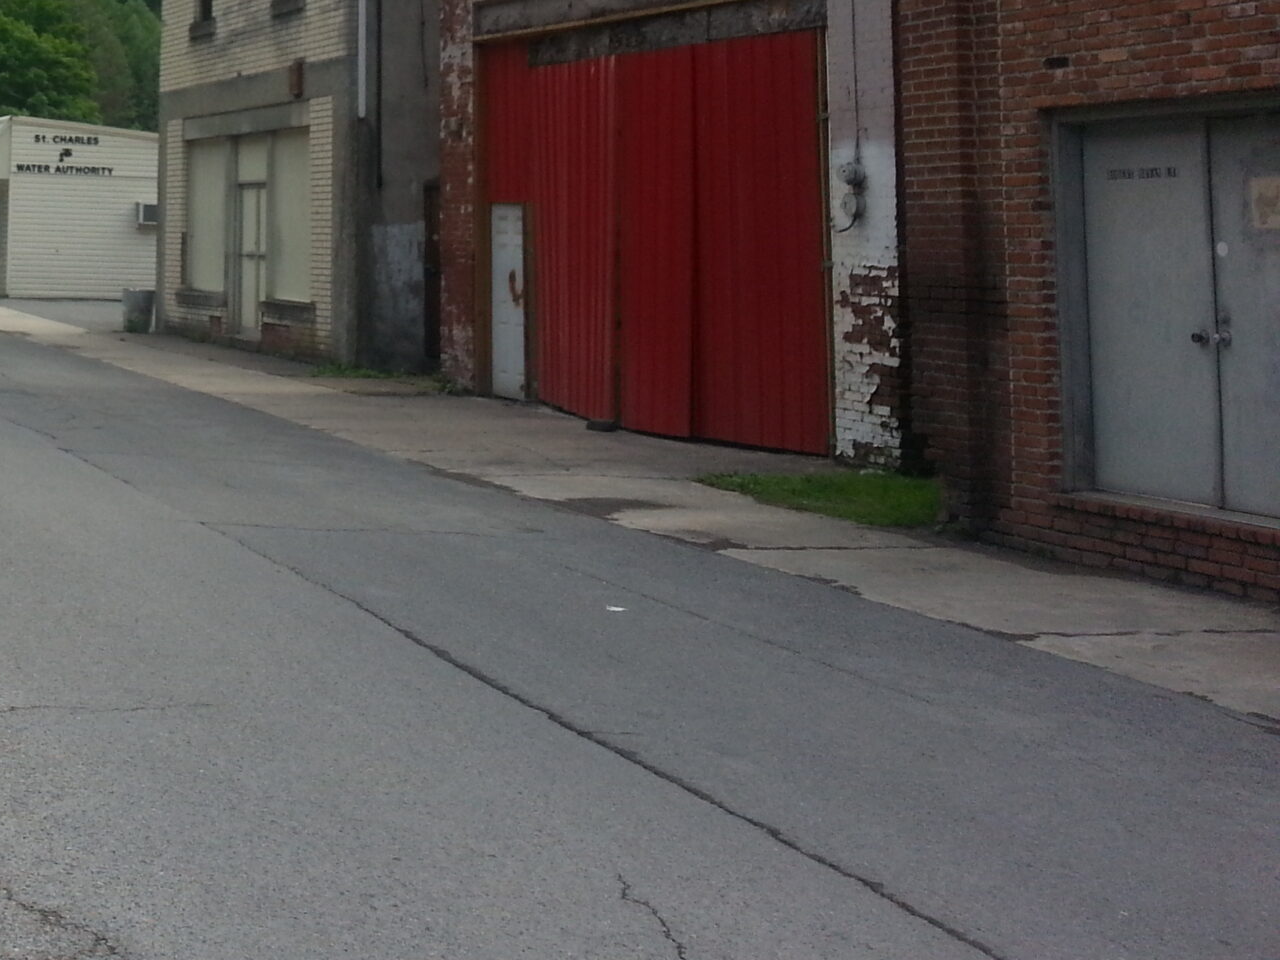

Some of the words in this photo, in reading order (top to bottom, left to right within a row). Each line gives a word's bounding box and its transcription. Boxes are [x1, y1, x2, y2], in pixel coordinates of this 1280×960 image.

[52, 135, 99, 145] CHARLES
[16, 164, 50, 173] WATER
[55, 165, 113, 175] AUTHORITY
